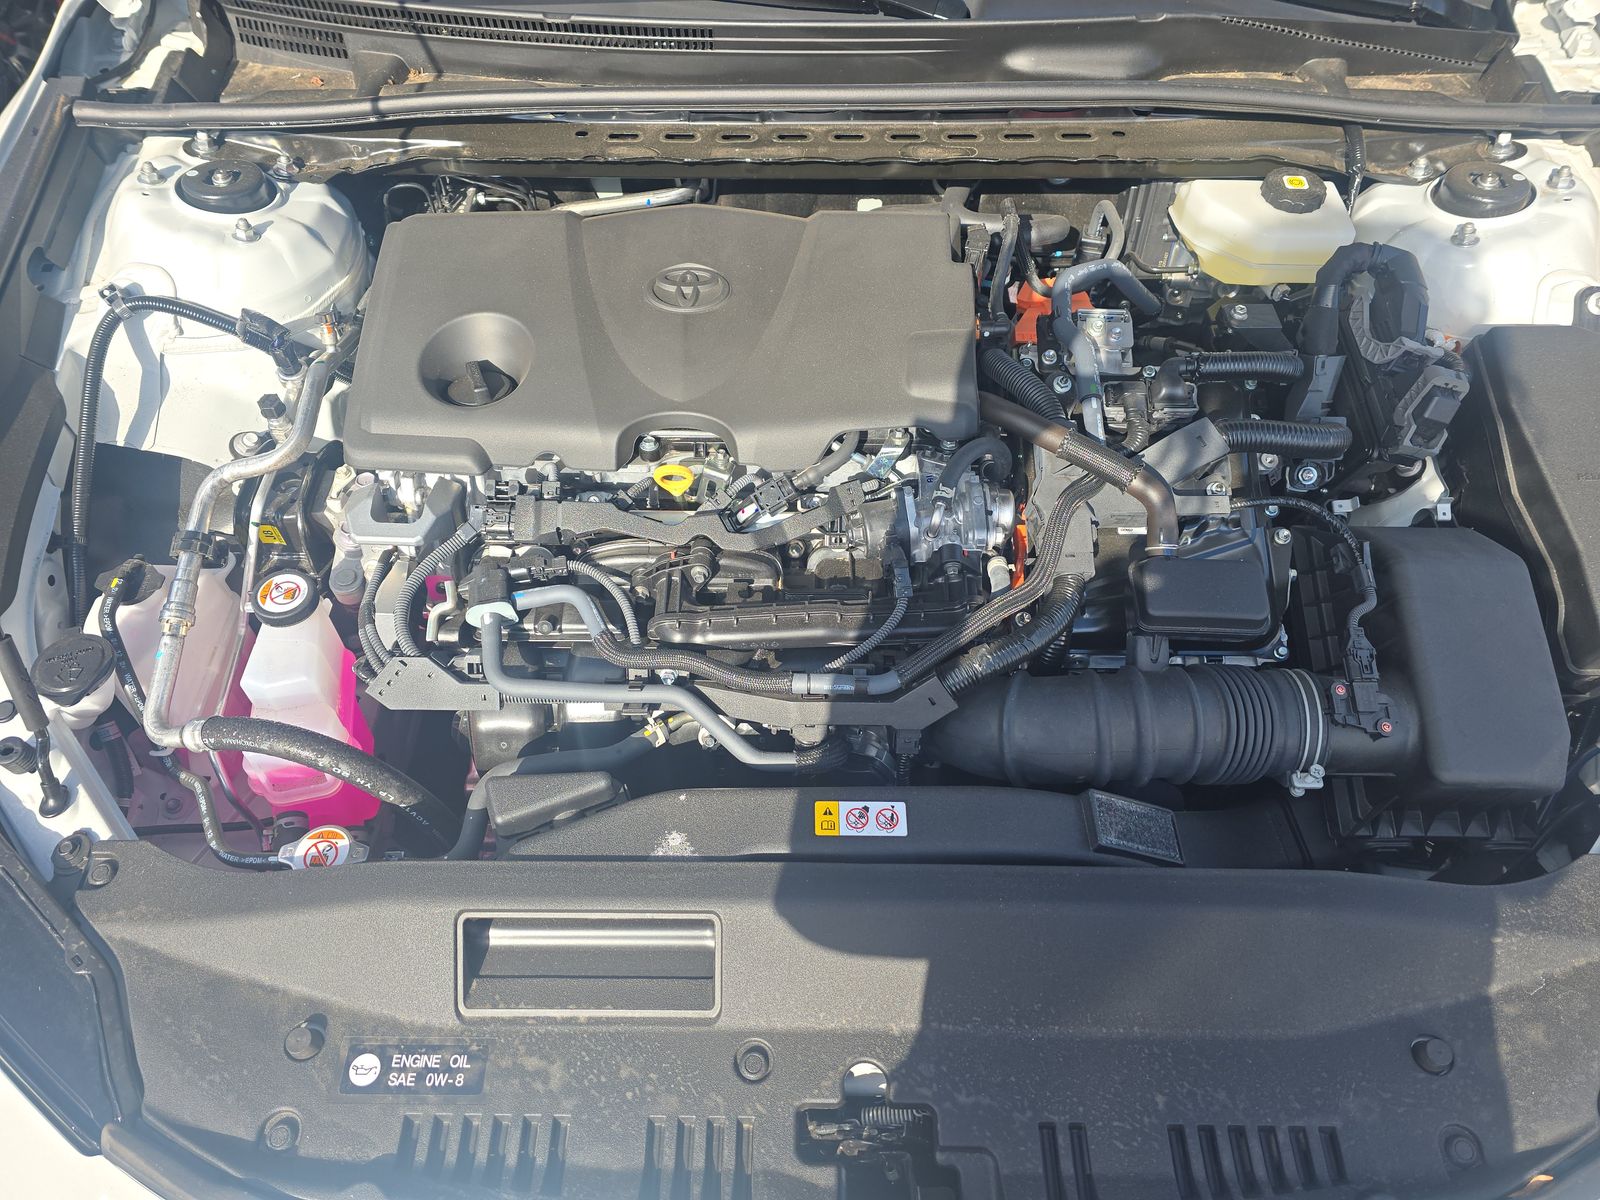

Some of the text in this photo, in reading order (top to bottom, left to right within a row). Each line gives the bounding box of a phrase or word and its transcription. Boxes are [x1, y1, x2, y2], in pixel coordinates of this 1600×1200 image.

[124, 672, 138, 693] WATER
[222, 738, 260, 748] YOKOHAMA
[218, 849, 240, 862] WATER
[391, 1054, 471, 1068] ENGINE OIL
[387, 1072, 465, 1087] SAE 0W-8
